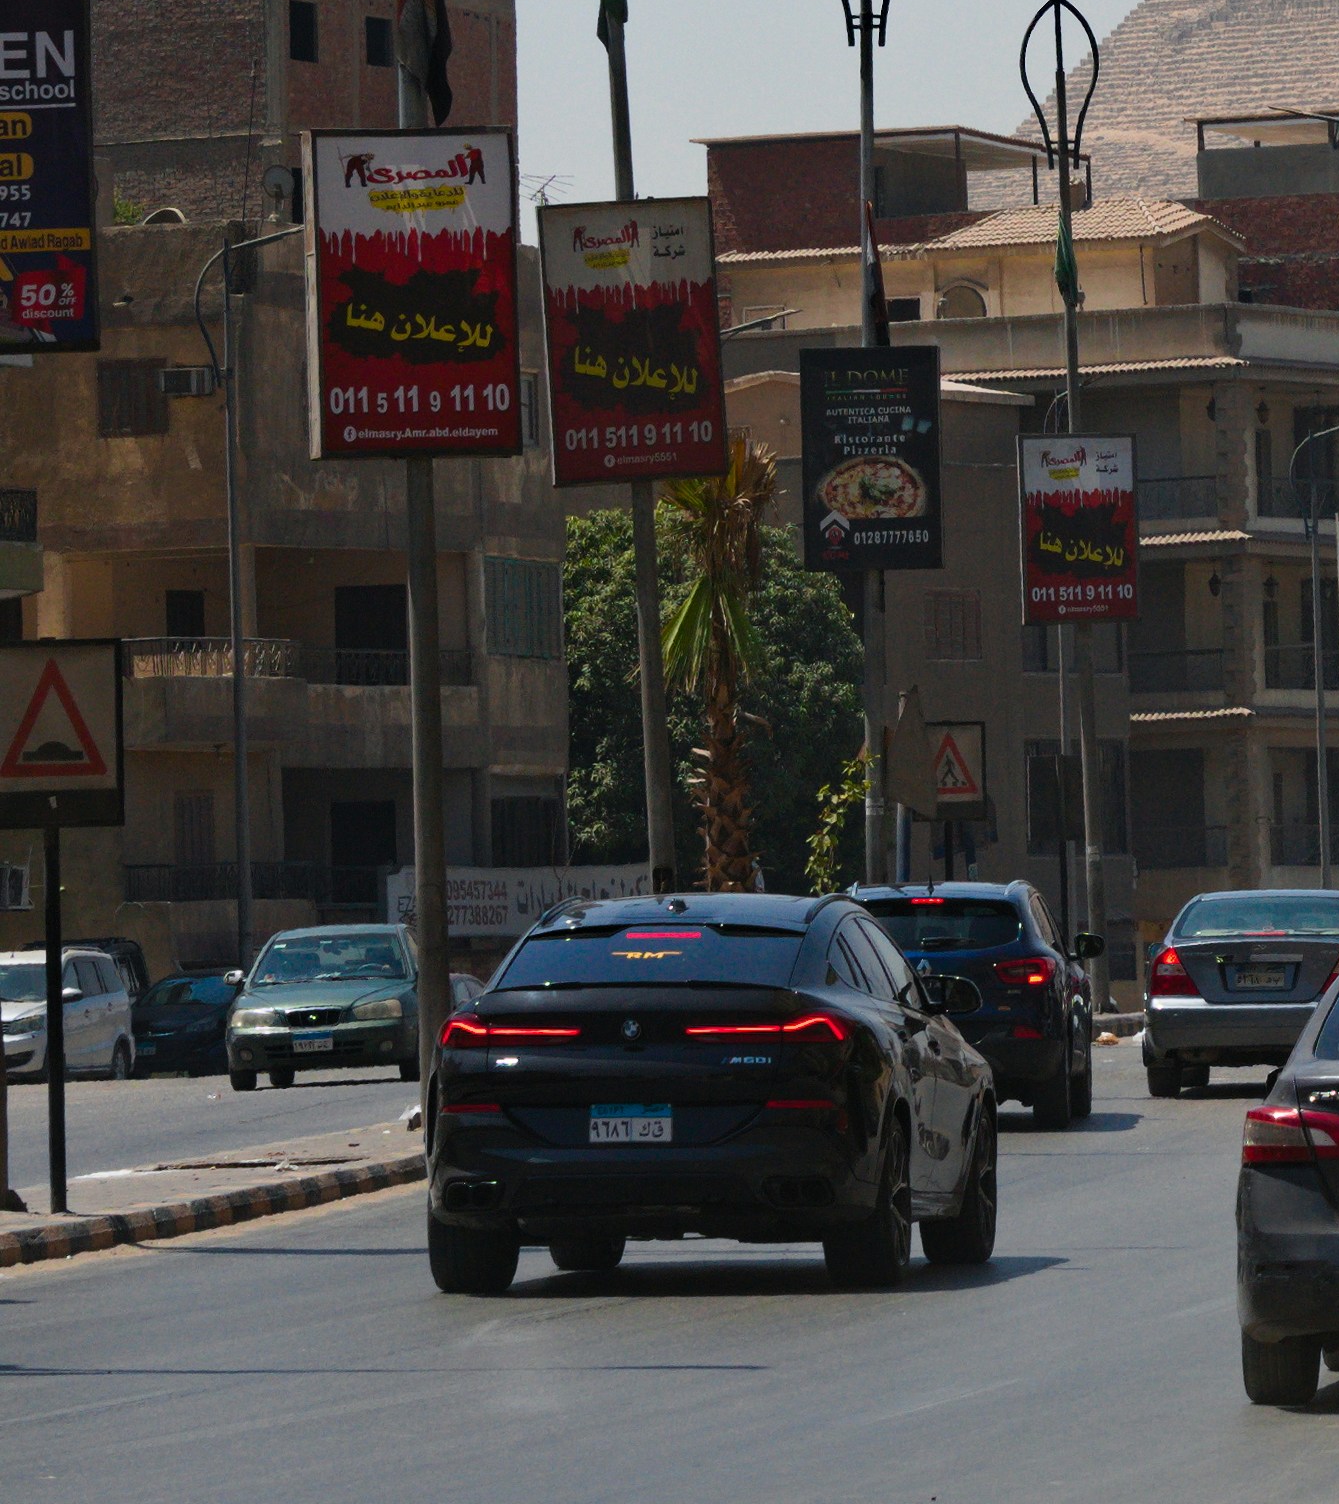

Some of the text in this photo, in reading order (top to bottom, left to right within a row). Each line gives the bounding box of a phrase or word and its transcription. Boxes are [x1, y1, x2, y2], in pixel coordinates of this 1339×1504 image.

[0, 79, 75, 100] school
[21, 284, 56, 306] 50
[58, 297, 77, 306] OFF
[22, 308, 74, 319] discount
[346, 302, 494, 353] للإعلان هنا
[574, 345, 698, 400] للإعلان هنا
[330, 383, 510, 414] 011 5 11 9 11 10
[826, 405, 912, 417] AUTENTICA CUCINA
[848, 415, 890, 424] ITALIANA
[566, 421, 713, 450] 011 511 9 11 10
[834, 433, 906, 444] Ristorante
[1040, 529, 1062, 553] هنا
[1032, 583, 1133, 602] 011 511 9 11 10
